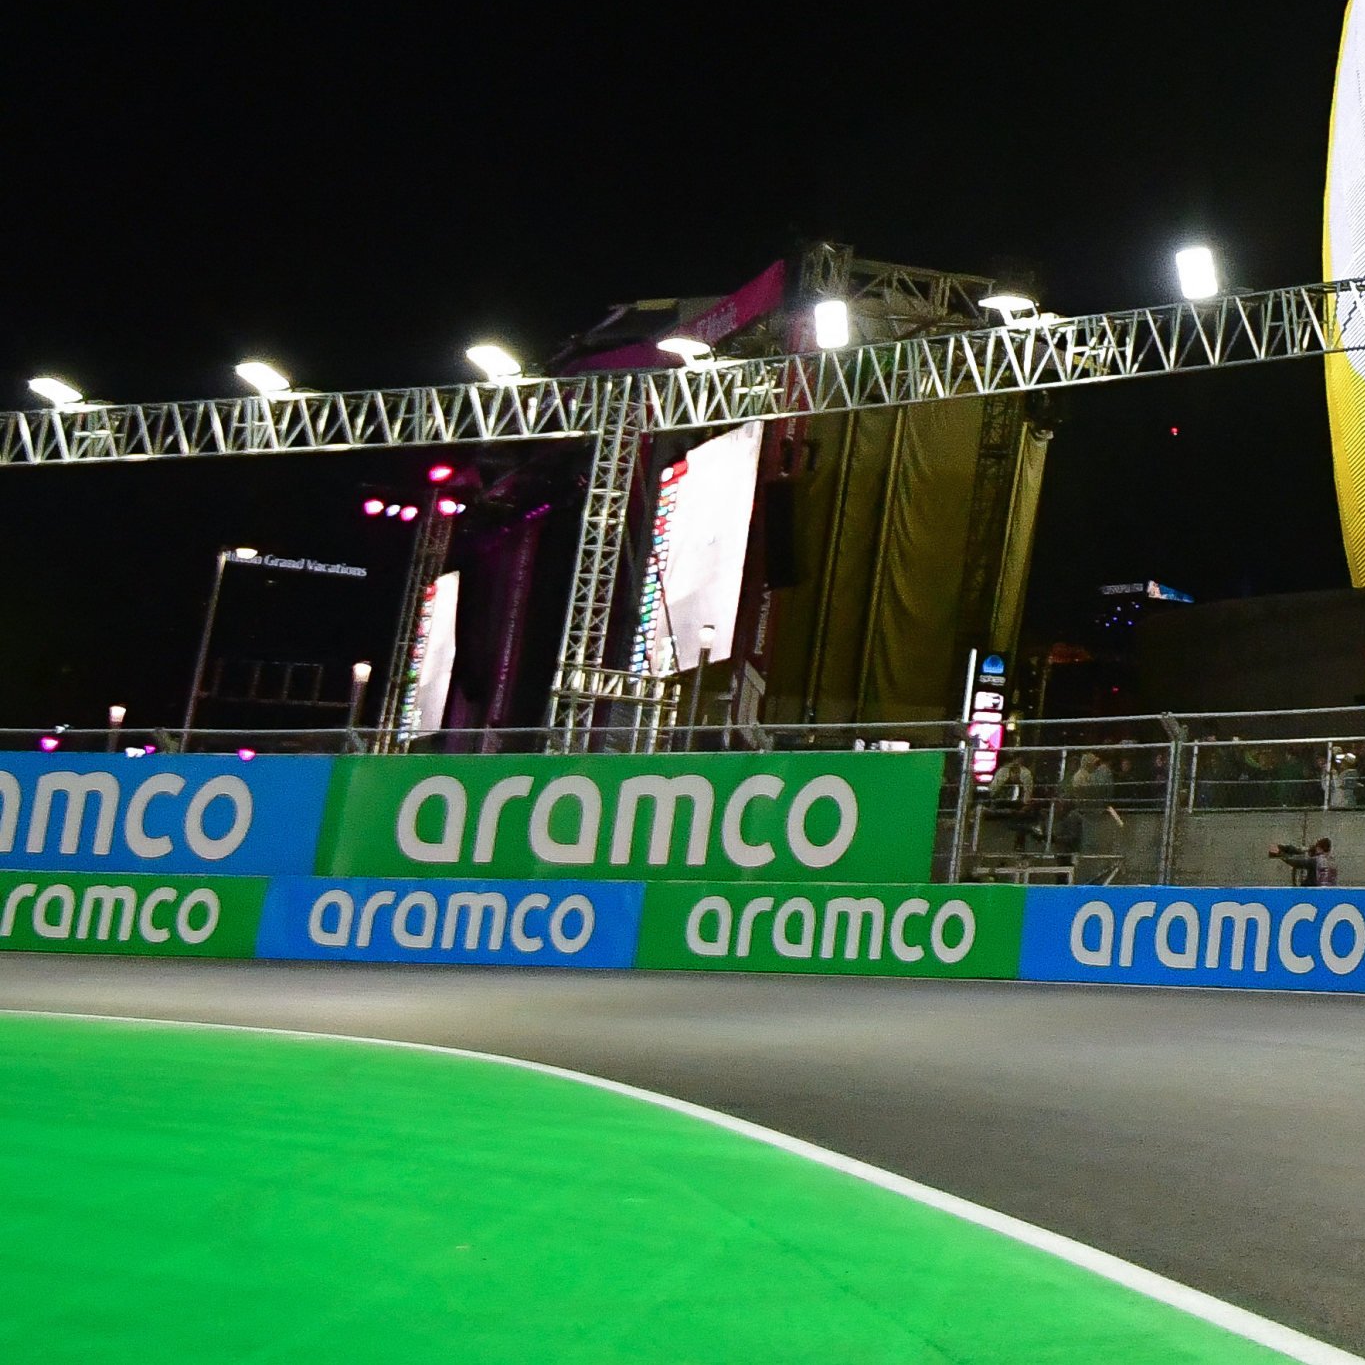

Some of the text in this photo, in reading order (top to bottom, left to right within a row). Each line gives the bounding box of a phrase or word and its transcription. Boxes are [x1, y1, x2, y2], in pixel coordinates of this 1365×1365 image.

[264, 554, 305, 569] Grand
[306, 559, 367, 577] Vacations
[396, 774, 858, 869] aramco
[308, 889, 595, 955] aramco
[686, 895, 976, 964] aramco
